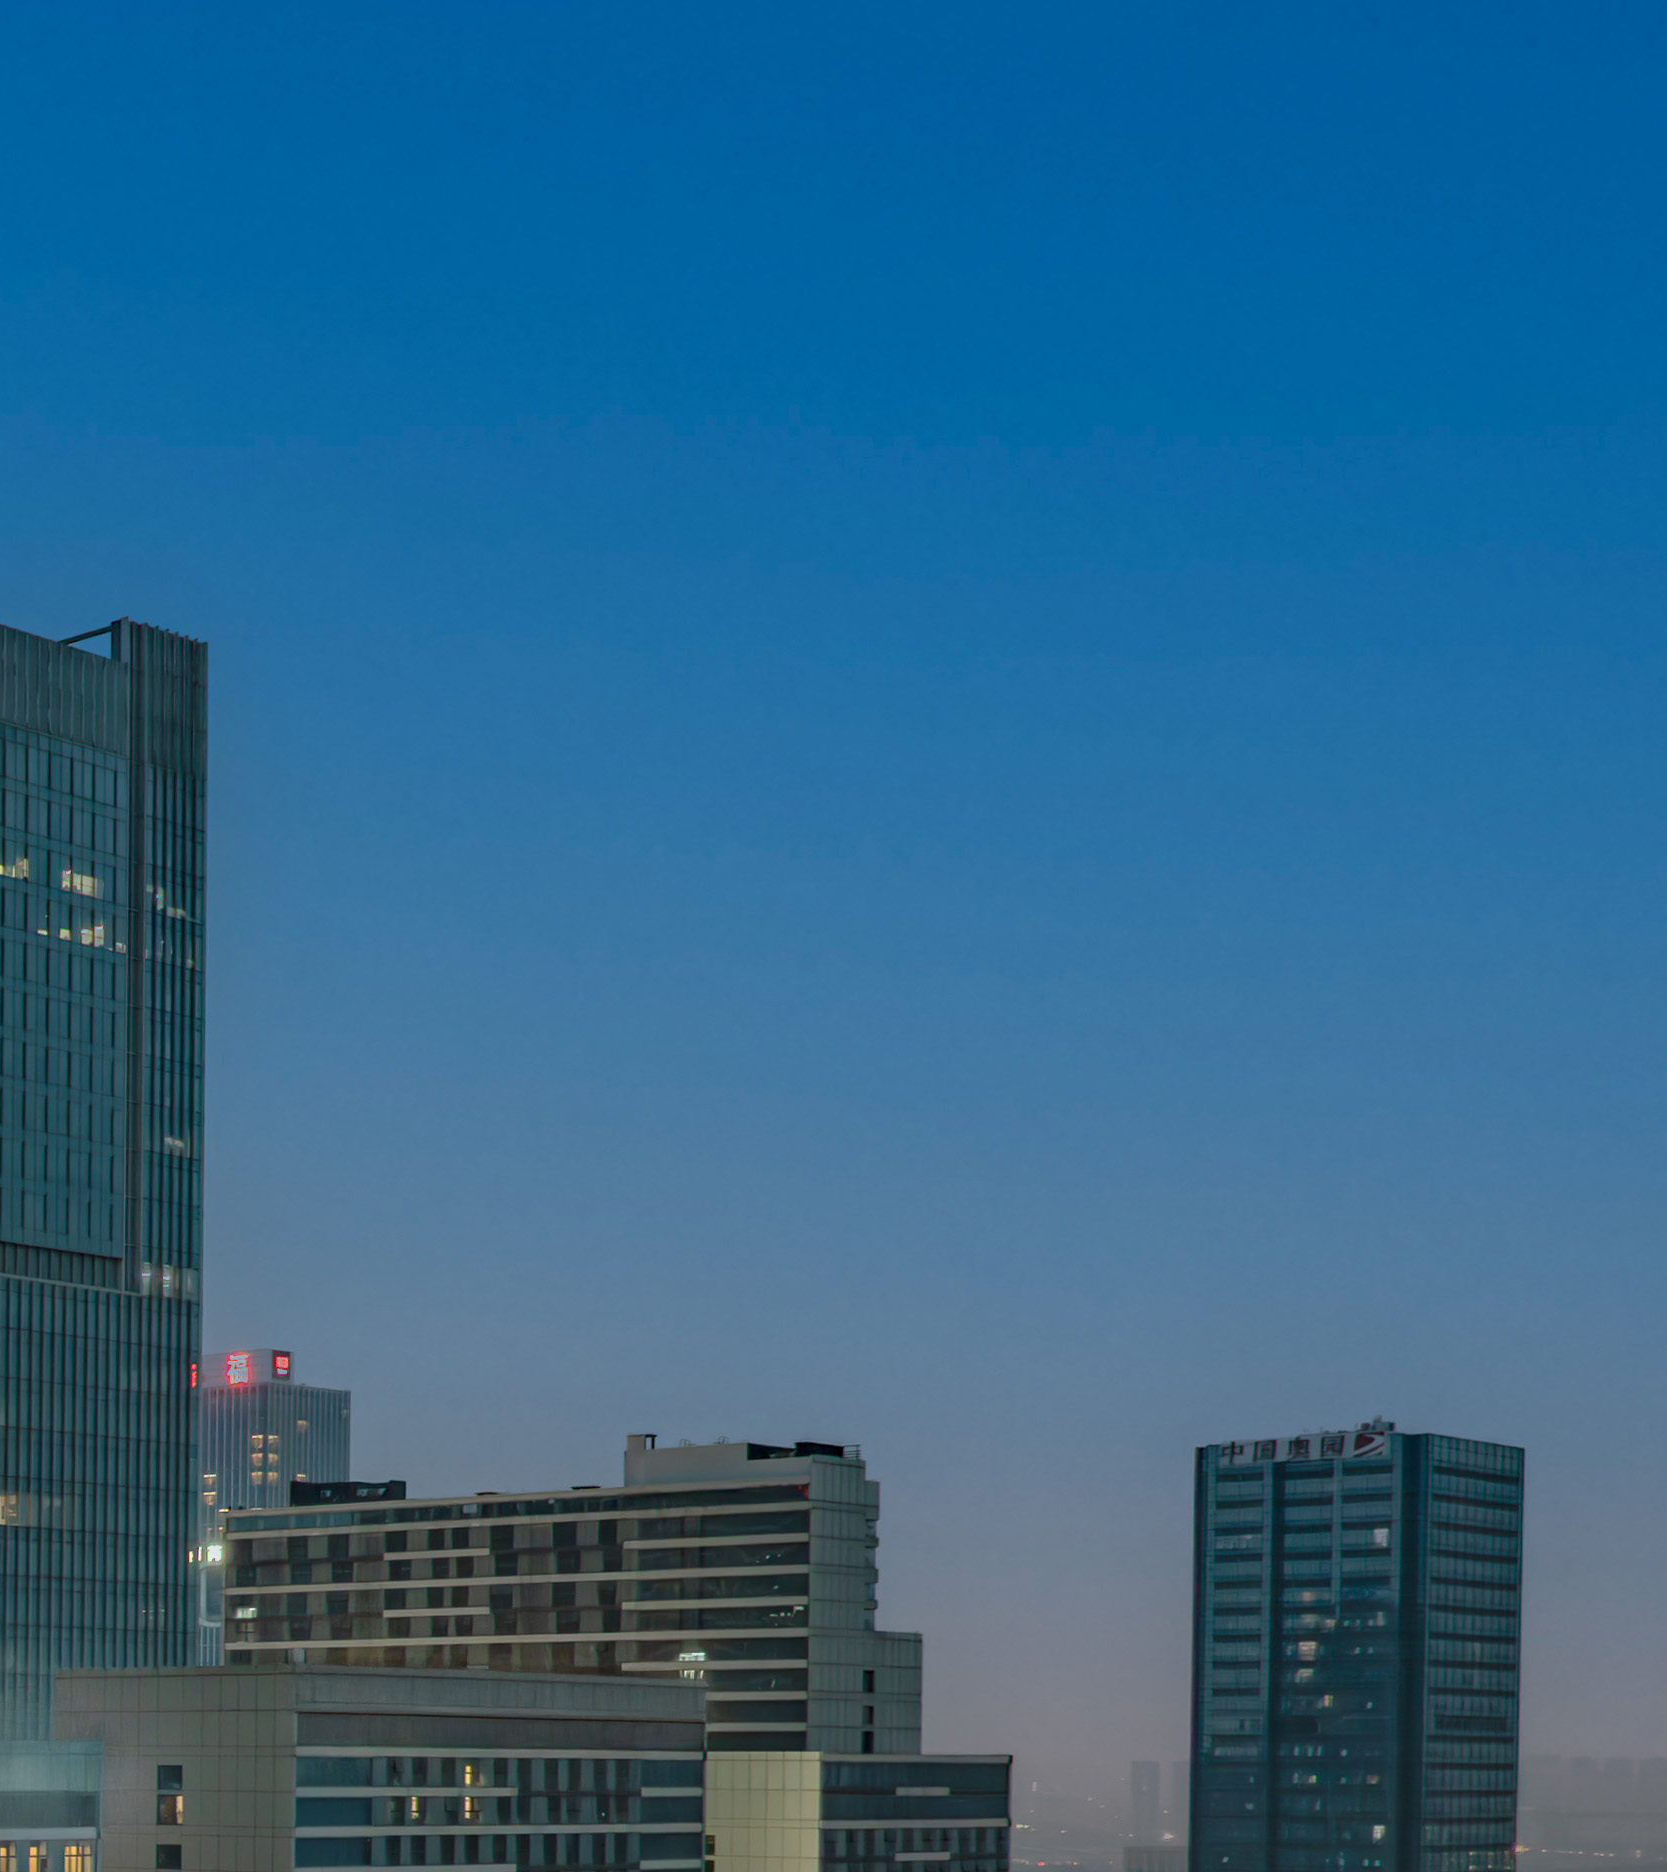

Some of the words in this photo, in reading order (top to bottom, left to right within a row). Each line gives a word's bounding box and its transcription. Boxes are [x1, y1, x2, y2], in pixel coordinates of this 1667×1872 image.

[227, 1354, 249, 1385] 福
[1221, 1434, 1346, 1465] 中国奥园
